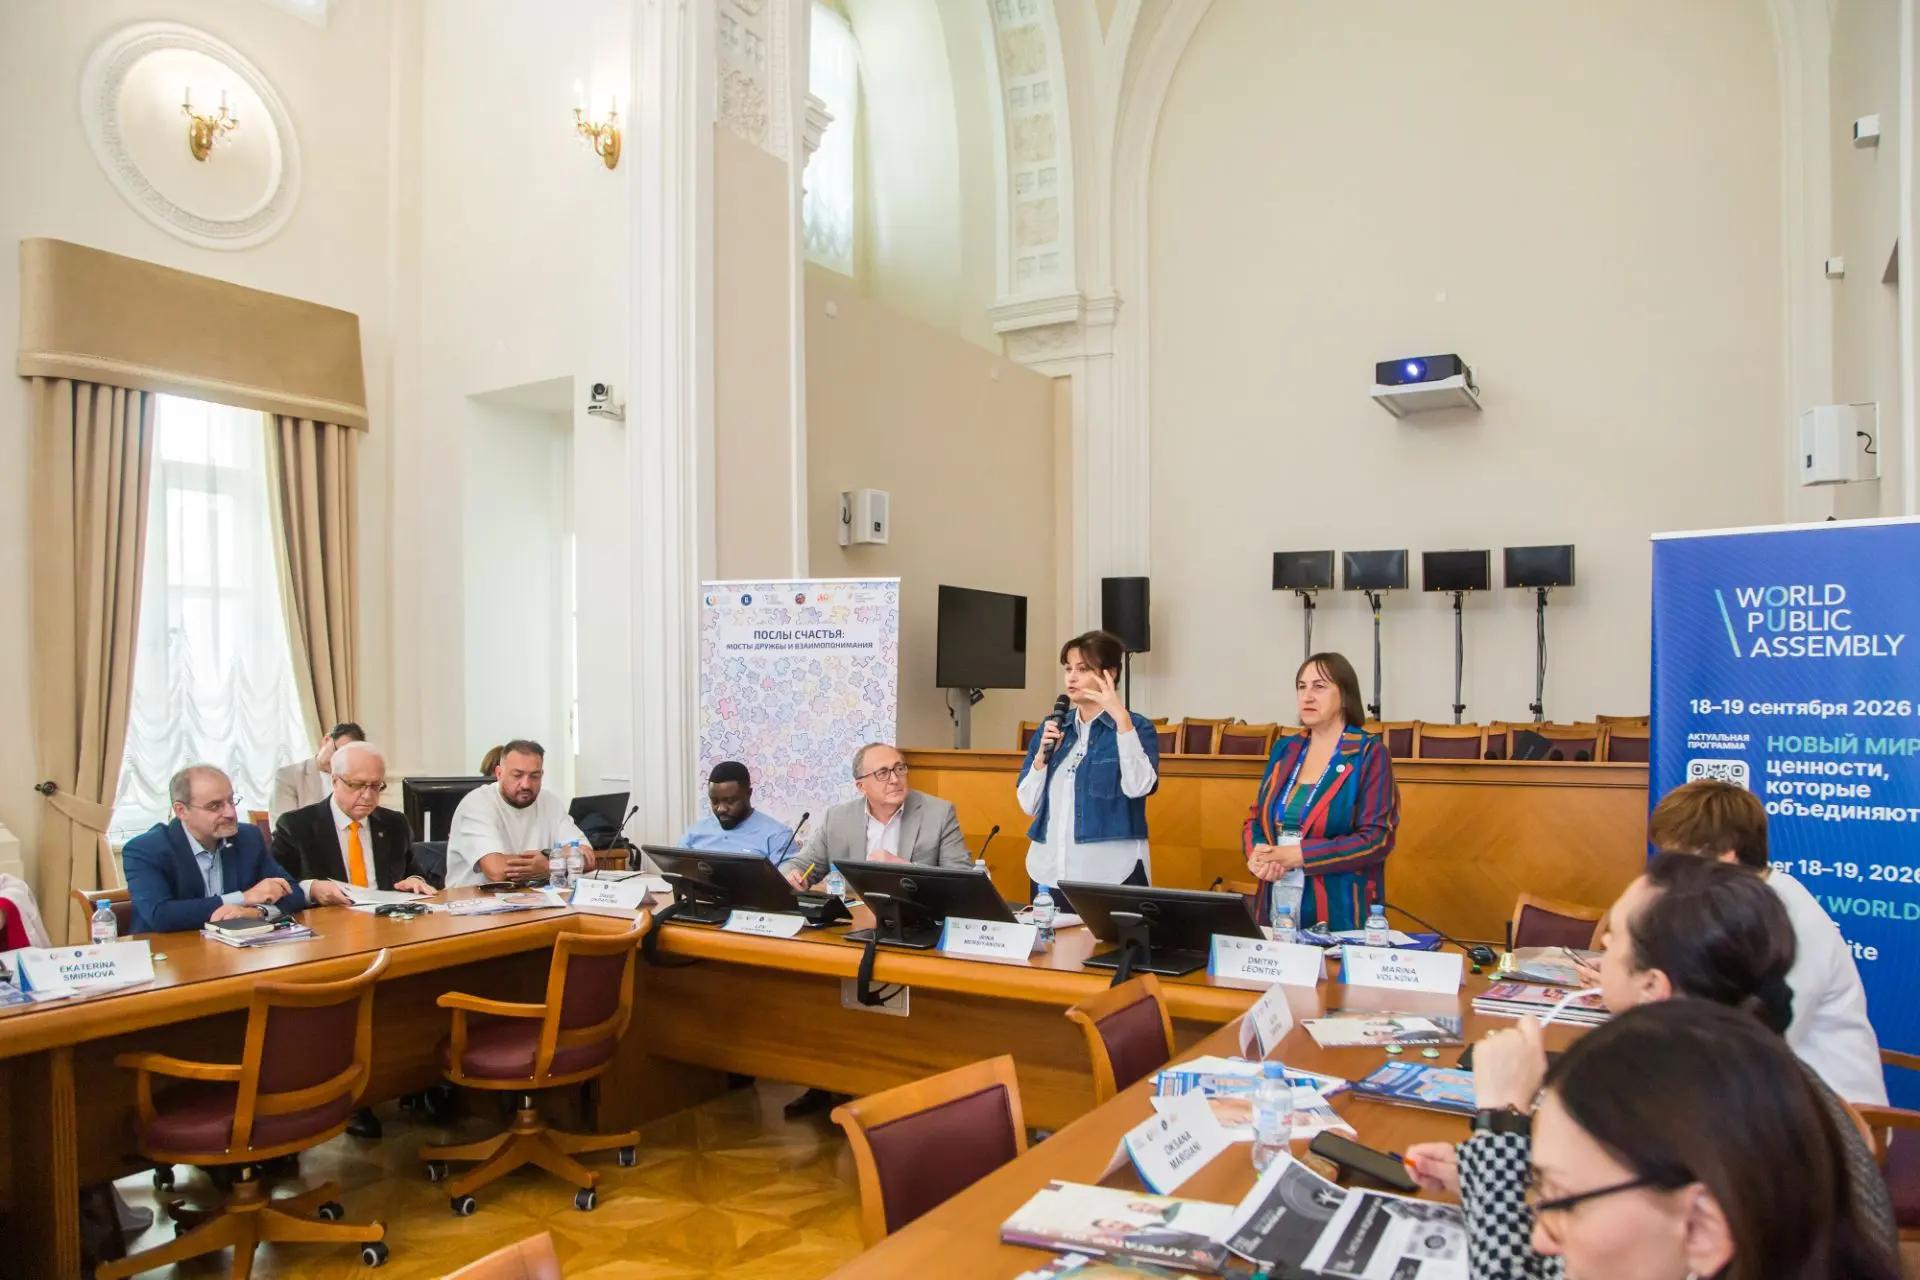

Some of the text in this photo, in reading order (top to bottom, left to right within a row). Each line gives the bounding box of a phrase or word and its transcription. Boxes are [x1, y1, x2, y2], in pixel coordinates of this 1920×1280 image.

[1735, 583, 1846, 608] WORLD
[1747, 608, 1852, 633] PUBLIC
[753, 629, 845, 640] ПОСЛЫ СЧАСТЬЯ:
[754, 643, 787, 651] ДРУЖБЫ
[794, 642, 873, 650] ВЗАИМОПОНИМАНИЯ
[1749, 634, 1905, 658] ASSEMBLY
[1748, 700, 1848, 719] сентября
[1853, 700, 1912, 717] 2026
[1687, 733, 1750, 742] АКТУАЛЬНАЯ
[1687, 741, 1746, 750] ПРОГРАММА
[1767, 733, 1920, 756] НОВЫЙ МИР
[1766, 759, 1889, 781] ценности,
[1766, 780, 1871, 800] которые
[1765, 799, 1920, 823] объединяют
[1827, 895, 1920, 921] WORLD
[60, 961, 116, 973] EKATERINA
[1248, 956, 1279, 967] DMITRY
[63, 970, 115, 981] SMIRNOVA
[1241, 965, 1282, 976] LEONTIEV
[1382, 965, 1416, 974] MARINA
[1376, 973, 1419, 983] VOLKOVA
